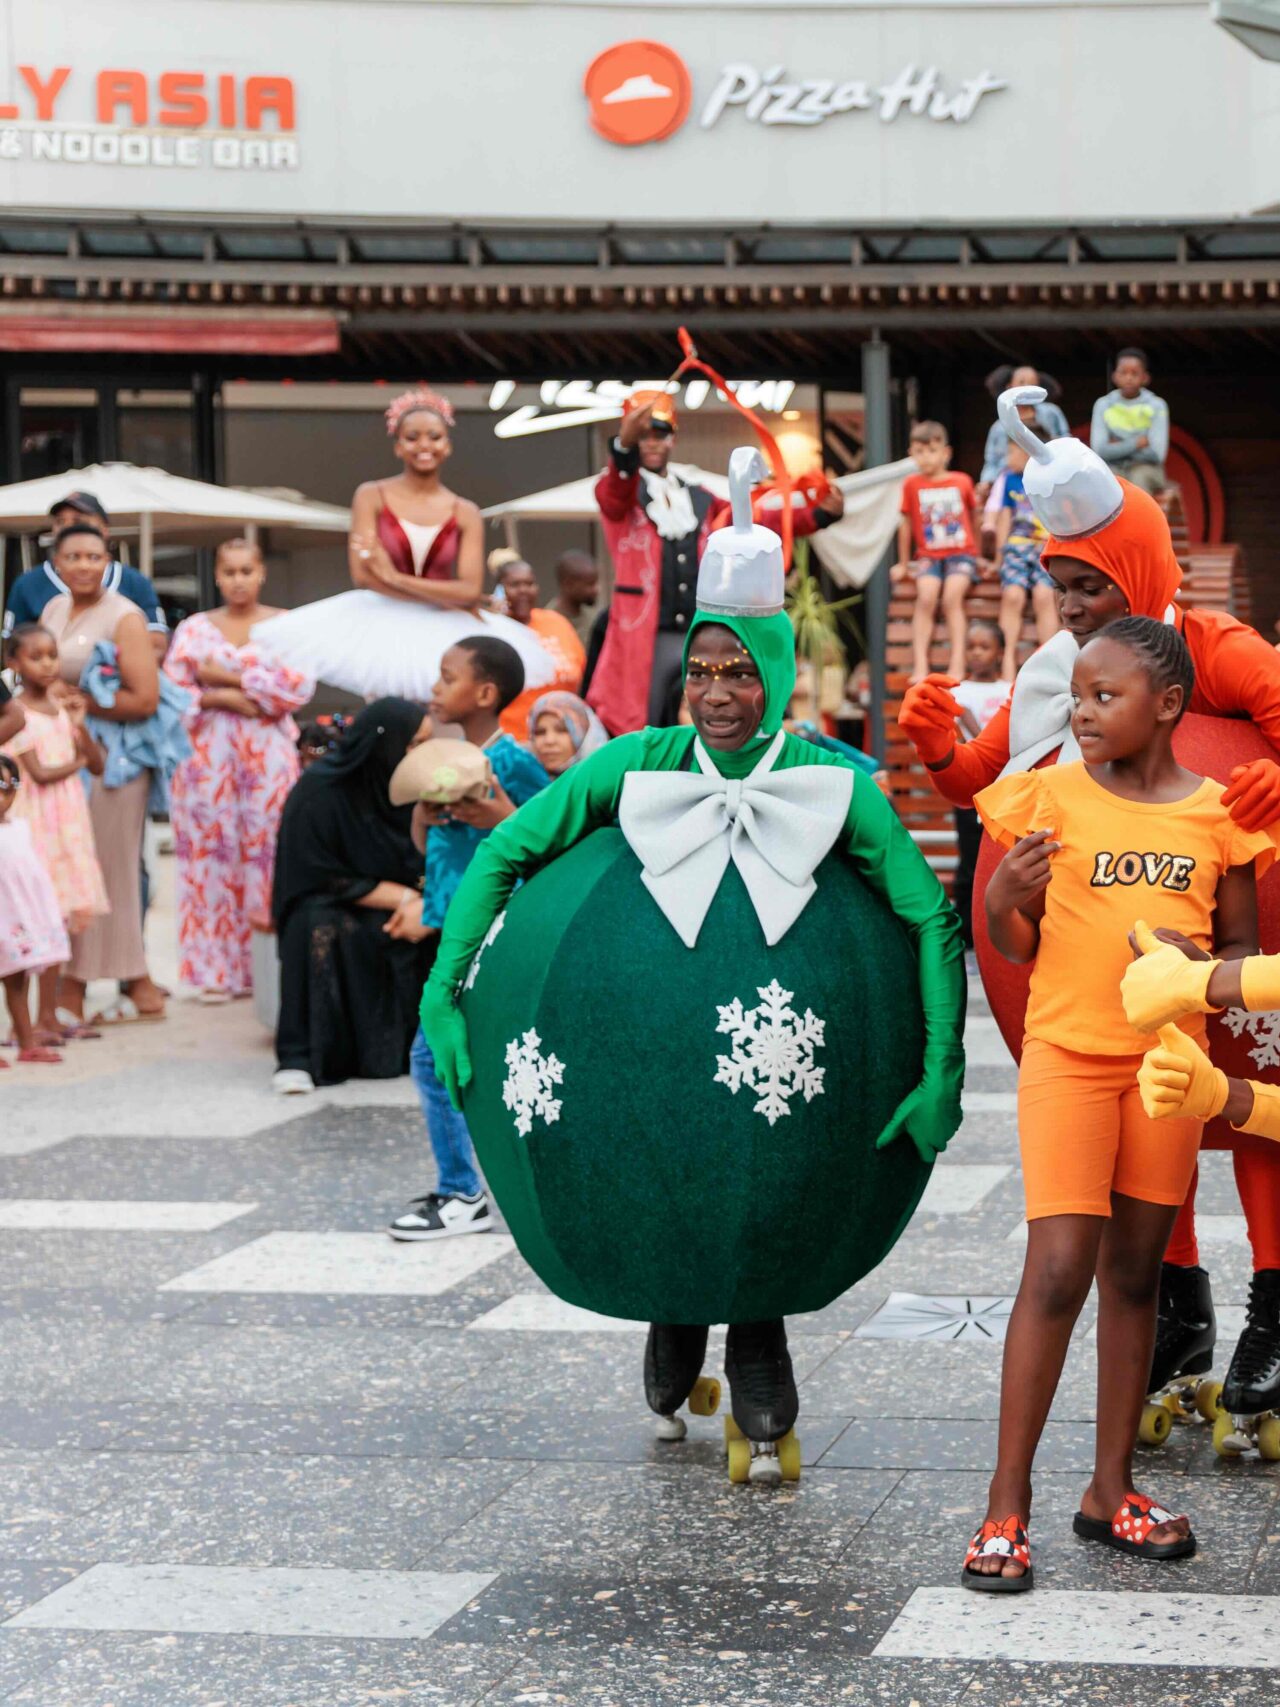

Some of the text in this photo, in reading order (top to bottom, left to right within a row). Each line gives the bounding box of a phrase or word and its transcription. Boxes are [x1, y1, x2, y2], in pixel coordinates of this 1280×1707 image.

[96, 69, 296, 130] ASIA
[700, 62, 1009, 130] Pizza Hut
[31, 132, 201, 166] NOODLE
[212, 137, 299, 169] BAR
[1090, 851, 1196, 892] LOVE
